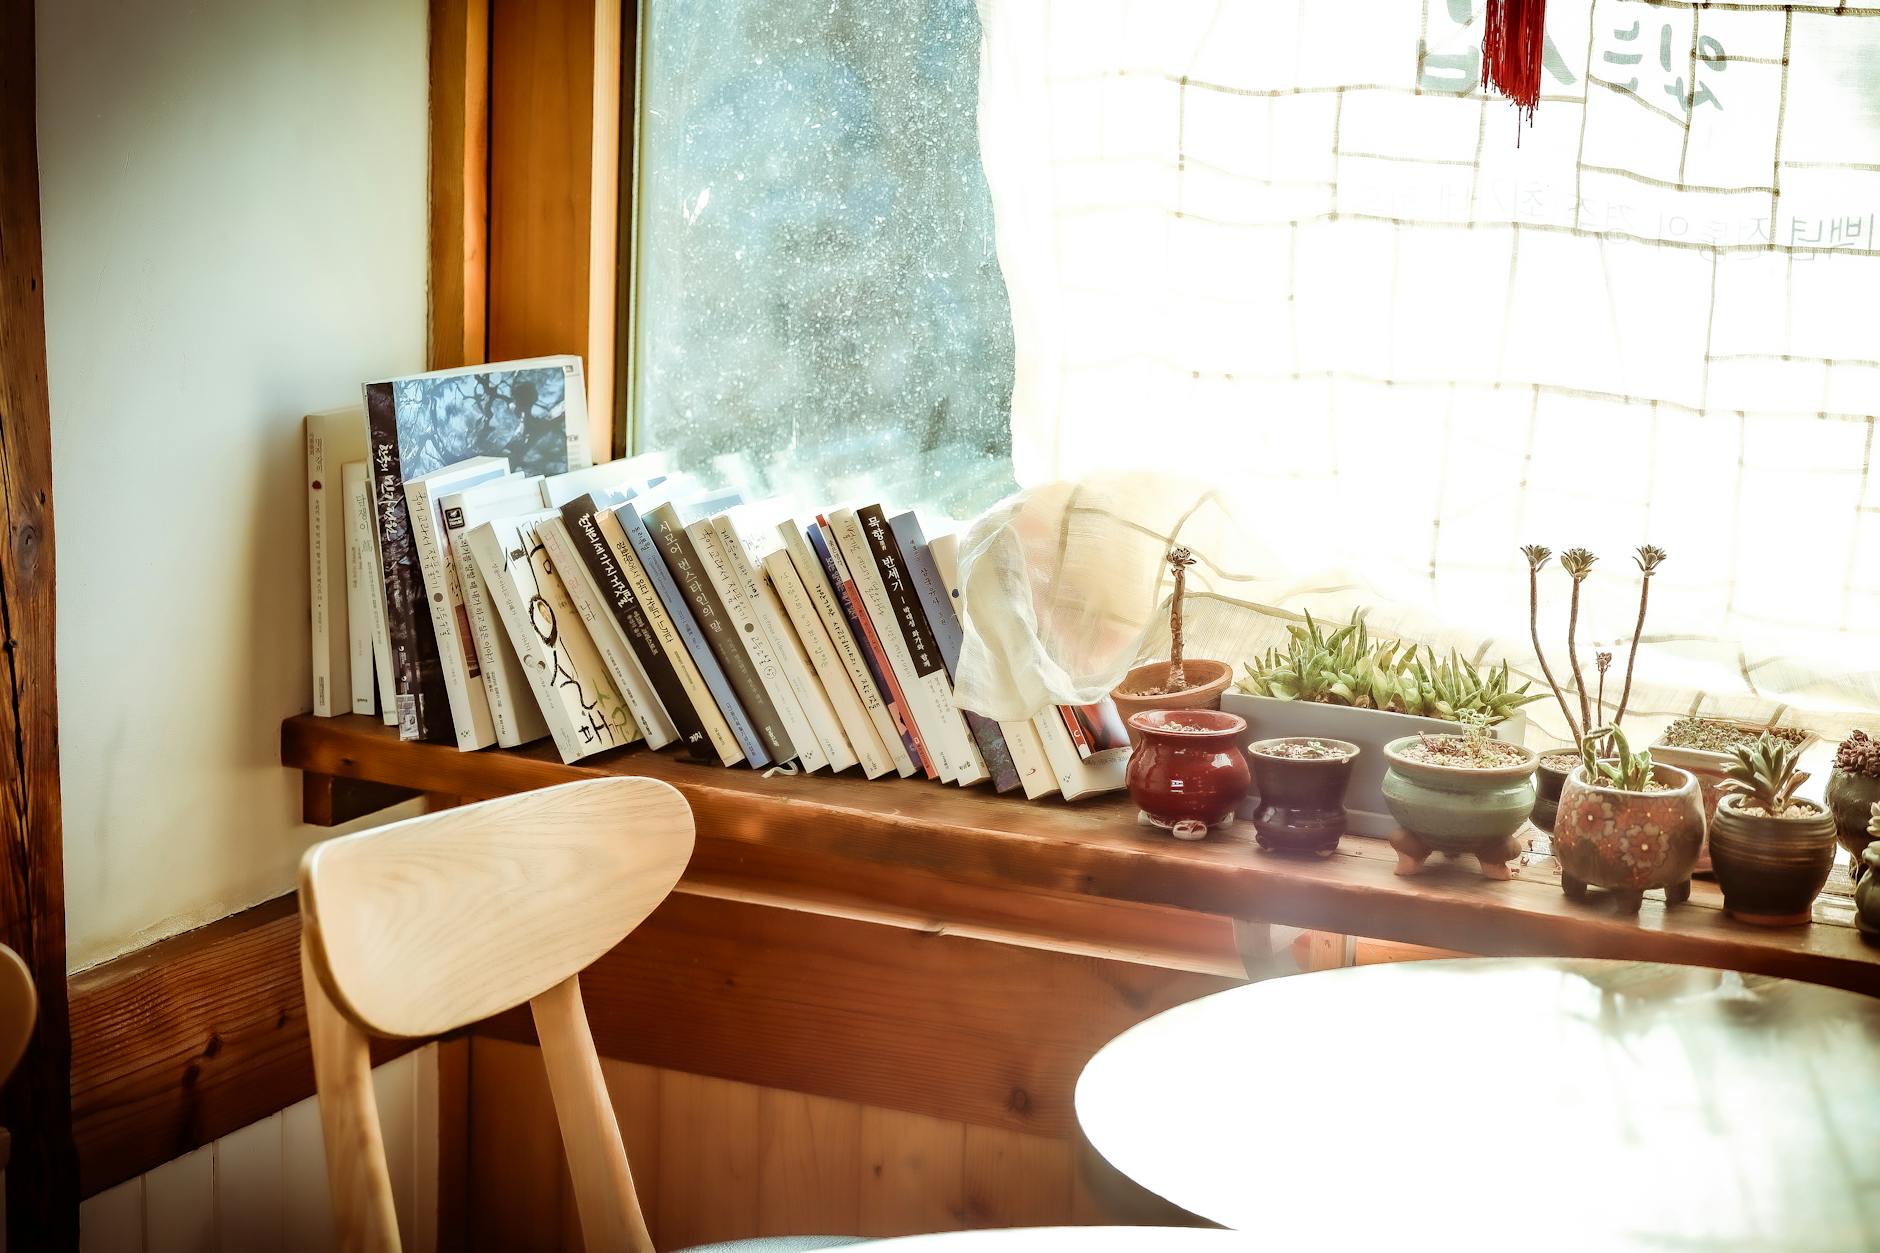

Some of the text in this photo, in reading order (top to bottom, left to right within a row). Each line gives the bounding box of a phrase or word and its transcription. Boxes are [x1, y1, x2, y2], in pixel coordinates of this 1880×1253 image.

[376, 444, 394, 472] 한국의
[411, 491, 427, 512] 국어
[416, 514, 432, 546] 교과서
[578, 512, 600, 544] 존재의
[610, 574, 634, 608] 거짓말
[698, 526, 715, 550] 국어
[708, 551, 730, 582] 교과서
[867, 516, 885, 541] 묵향
[881, 555, 904, 592] 반세기
[468, 580, 477, 589] 때
[660, 520, 683, 554] 시모어
[677, 557, 715, 617] 번스타인의
[709, 619, 722, 633] 말
[470, 590, 481, 605] 내가
[616, 541, 638, 576] 광화문에서
[635, 578, 649, 596] 읽다
[645, 596, 662, 619] 거닐다
[656, 619, 674, 644] 느끼다
[475, 607, 485, 622] 하고
[477, 624, 488, 639] 싶은
[483, 641, 495, 664] 이야기
